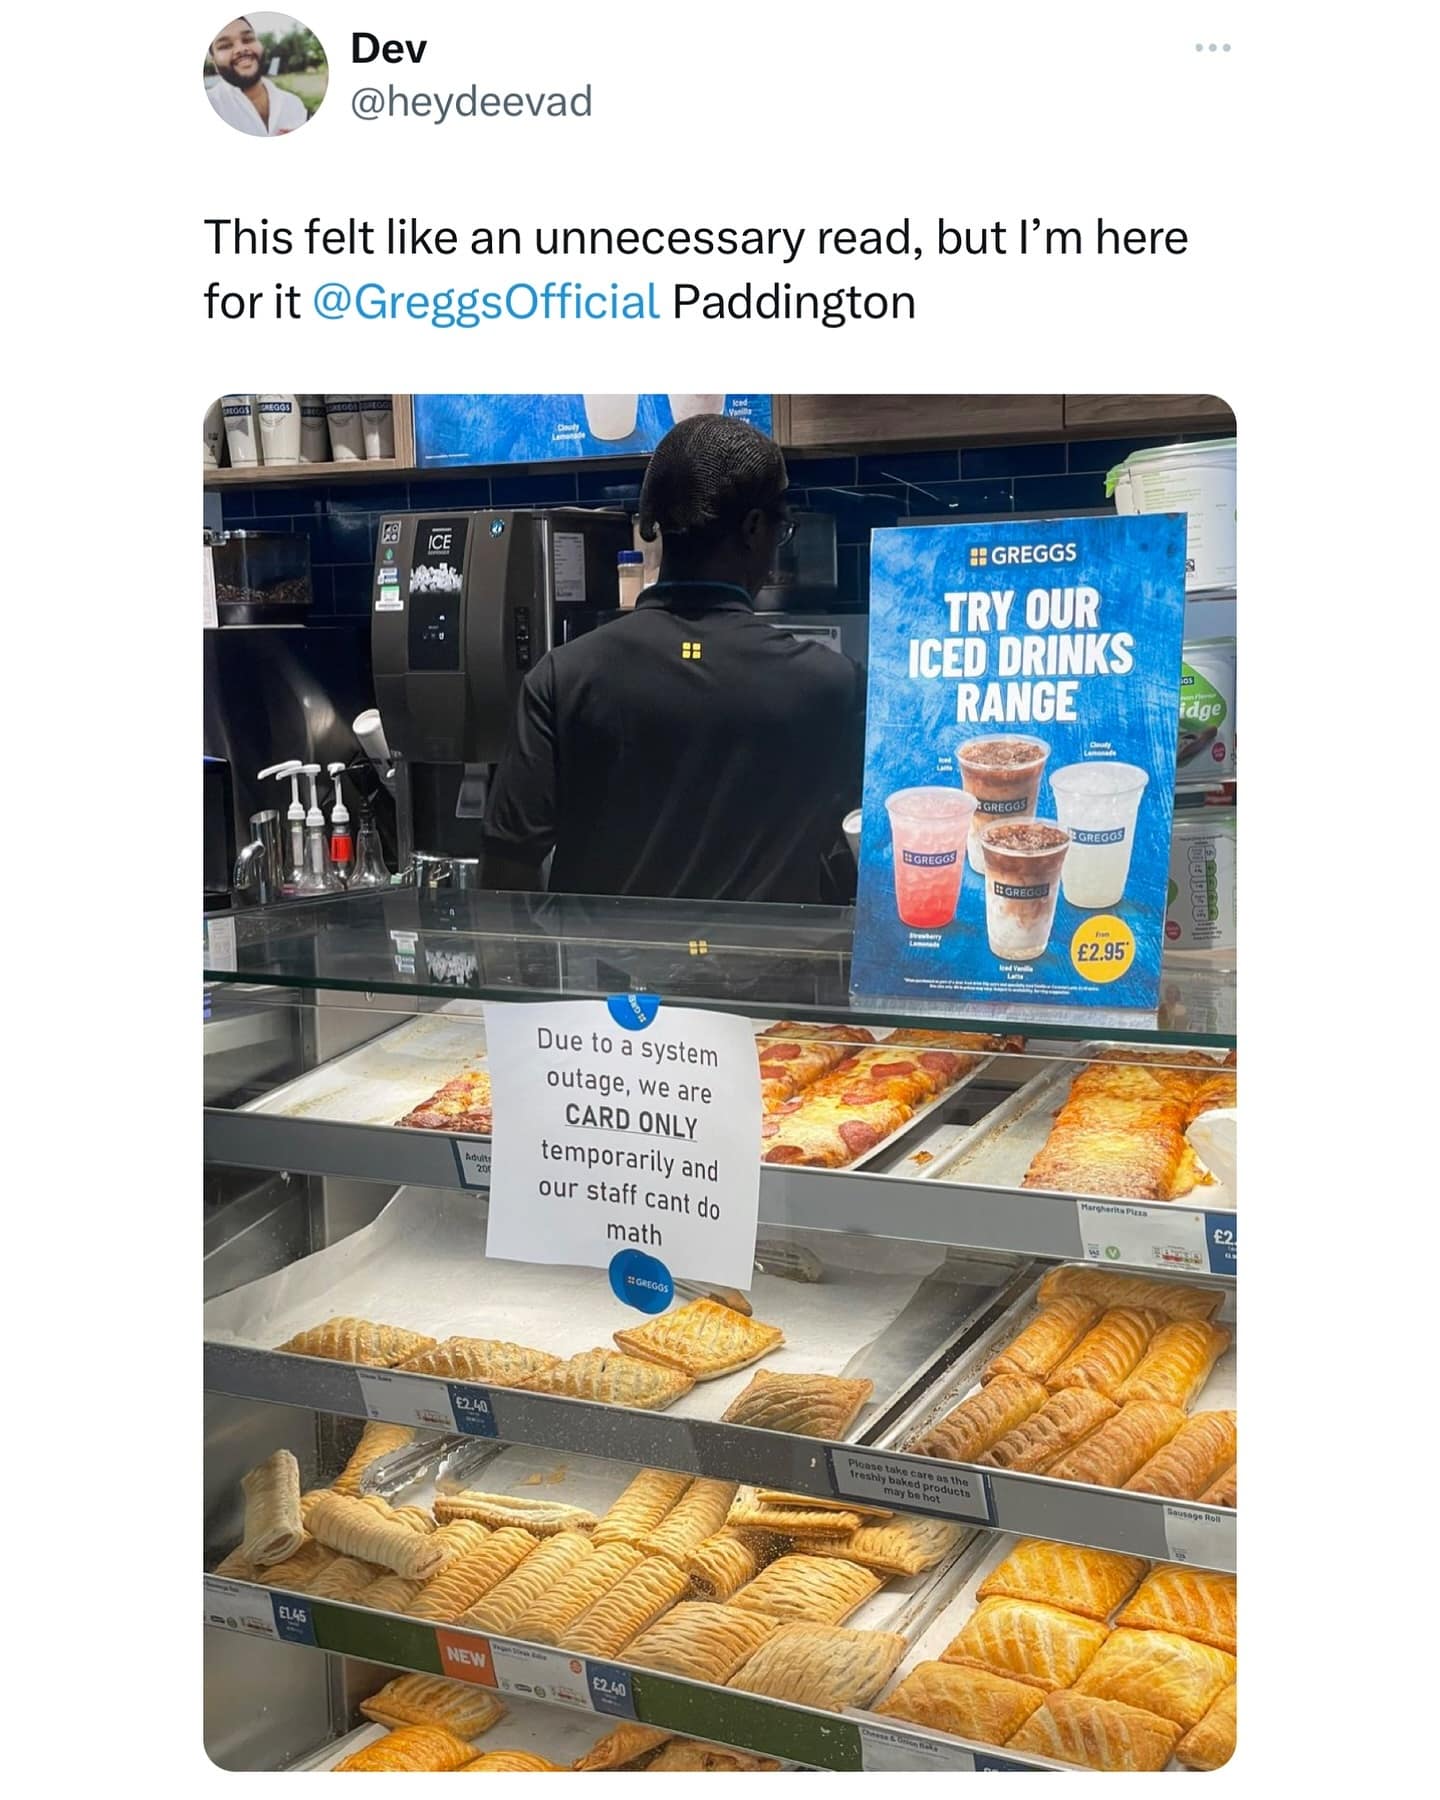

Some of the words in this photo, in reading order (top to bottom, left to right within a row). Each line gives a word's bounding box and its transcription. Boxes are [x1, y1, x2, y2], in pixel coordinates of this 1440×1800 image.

[428, 535, 453, 550] ICE
[991, 543, 1077, 565] GREGGS
[944, 590, 1015, 633] TRY
[1025, 586, 1099, 630] OUR
[908, 637, 987, 680] ICED
[997, 631, 1135, 677] DRINKS
[956, 680, 1079, 723] RANGE
[1179, 701, 1222, 722] idge
[983, 800, 1026, 813] GREGGS
[1078, 830, 1123, 843] GREGGS
[914, 852, 956, 866] GREGGS
[1004, 884, 1048, 898] GREGGS
[537, 1028, 583, 1051] Due
[592, 1032, 612, 1054] to
[621, 1040, 632, 1056] a
[642, 1040, 718, 1067] system
[547, 1070, 630, 1097] outage,
[638, 1078, 669, 1097] we
[678, 1084, 712, 1104] are
[565, 1103, 630, 1130] CARD
[639, 1111, 698, 1139] ONLY
[541, 1139, 674, 1179] temporarily
[682, 1160, 718, 1182] and
[539, 1180, 578, 1198] our
[587, 1181, 637, 1206] staff
[645, 1191, 690, 1215] cant
[698, 1197, 720, 1220] do
[1081, 1203, 1125, 1215] Margherita
[1126, 1208, 1148, 1217] Pizza
[607, 1222, 662, 1246] math
[635, 1277, 669, 1293] GREGGS
[456, 1396, 488, 1413] £2.40
[849, 1458, 883, 1472] Please
[885, 1463, 909, 1476] take
[911, 1470, 934, 1481] care
[936, 1474, 949, 1483] as
[951, 1475, 969, 1487] the
[850, 1470, 886, 1485] freshly
[889, 1476, 921, 1489] baked
[923, 1483, 971, 1498] products
[884, 1487, 905, 1499] may
[907, 1490, 921, 1500] be
[923, 1493, 941, 1504] hot
[1167, 1508, 1203, 1520] Sausage
[1204, 1513, 1222, 1523] Roll
[446, 1646, 487, 1668] NEW
[592, 1676, 627, 1697] £2.40
[862, 1729, 889, 1741] Cheese
[897, 1737, 918, 1748] Onion
